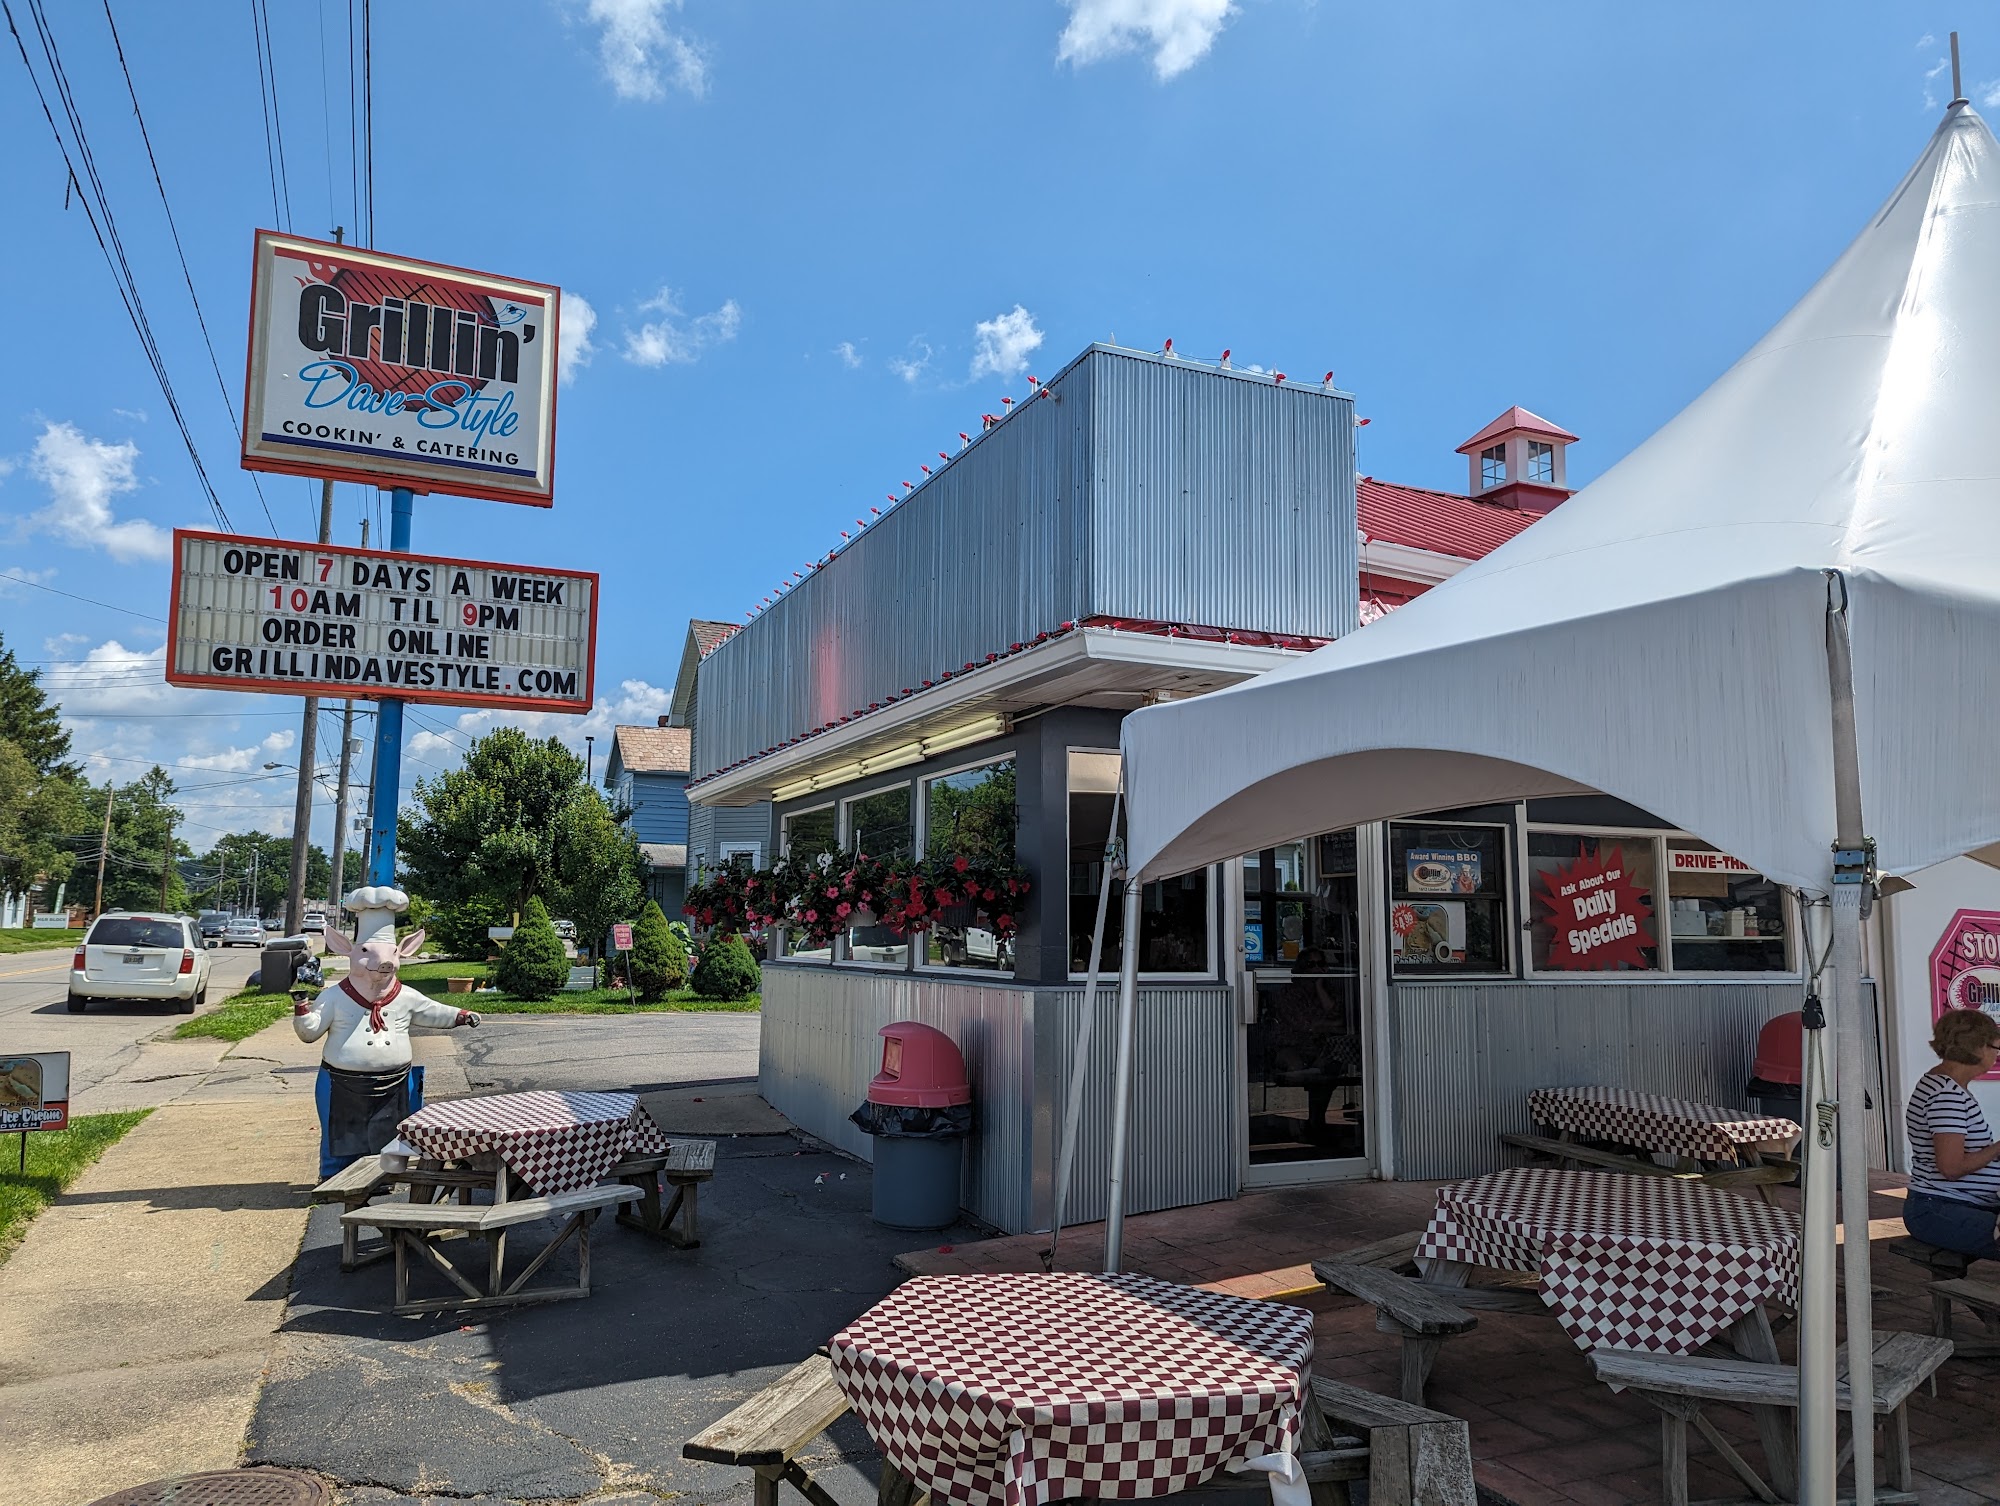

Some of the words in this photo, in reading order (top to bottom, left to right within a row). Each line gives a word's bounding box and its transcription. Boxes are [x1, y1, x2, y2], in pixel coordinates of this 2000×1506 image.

[298, 283, 536, 384] Grillin'
[282, 420, 382, 445] COOKIN'
[392, 436, 405, 449] &
[416, 439, 520, 465] CATERING
[224, 549, 299, 581] OPEN
[317, 558, 333, 582] 7
[353, 562, 431, 592] DAYS
[451, 572, 471, 595] A
[491, 575, 565, 605] WEEK
[270, 585, 360, 617] 10AM
[390, 598, 440, 624] TIL
[463, 603, 519, 631] 9PM
[263, 618, 356, 649] ORDER
[388, 628, 489, 659] ONLINE
[212, 646, 576, 695] GRILLINDAVESTYLE.COM
[1410, 852, 1429, 860] Award
[1431, 852, 1454, 862] Winning
[1457, 853, 1478, 862] BBQ
[1675, 854, 1754, 870] DRIVE-TH
[1560, 883, 1577, 897] Ask
[1579, 874, 1604, 891] About
[1606, 869, 1621, 881] Our
[1573, 889, 1616, 921] Daily
[1568, 913, 1637, 955] Specials
[2, 1110, 20, 1124] Ice
[22, 1108, 61, 1121] Cream
